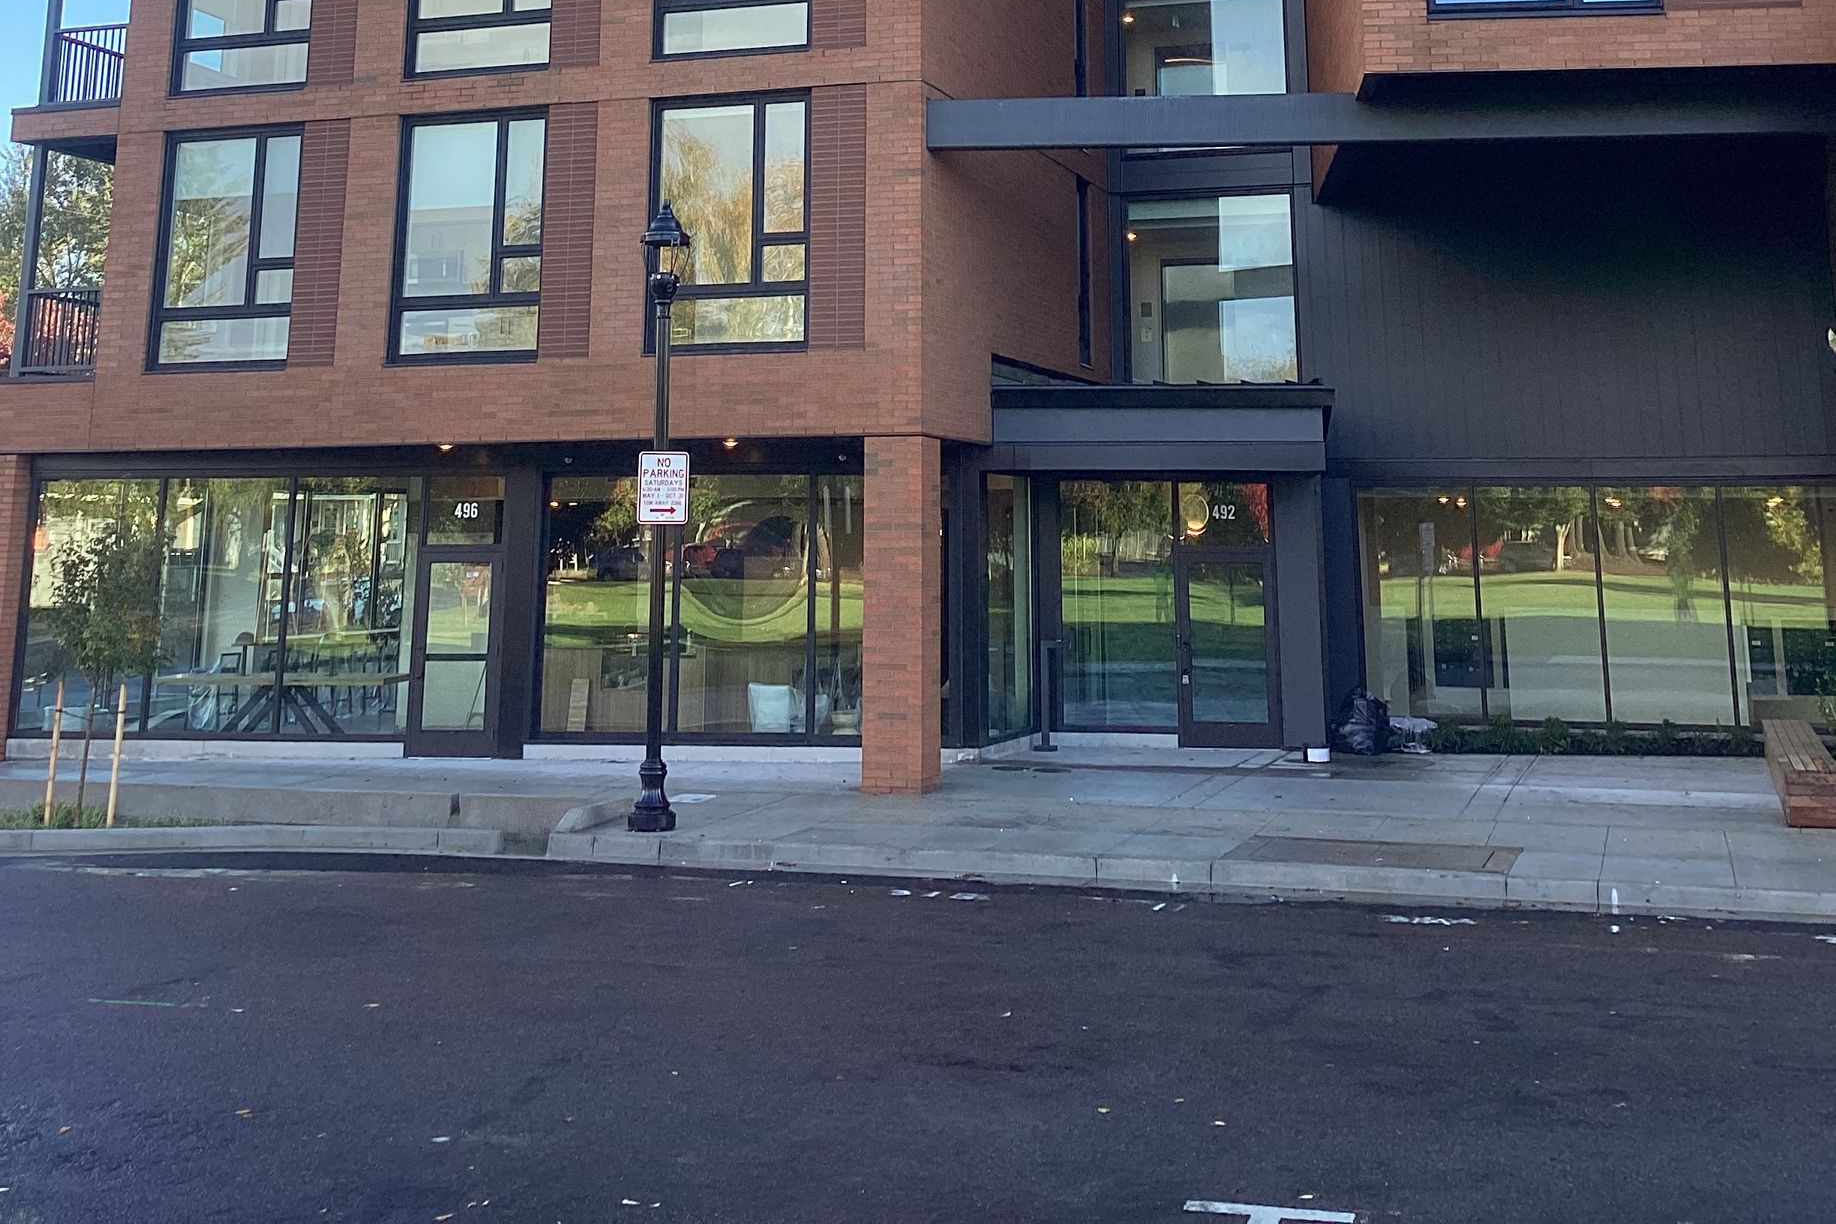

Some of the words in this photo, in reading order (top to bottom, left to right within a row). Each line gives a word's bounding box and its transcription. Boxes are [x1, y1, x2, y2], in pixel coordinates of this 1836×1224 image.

[657, 457, 671, 468] NO
[643, 468, 685, 478] PARKING
[644, 479, 683, 487] SATURDAYS
[454, 502, 479, 519] 496
[1212, 504, 1236, 519] 492
